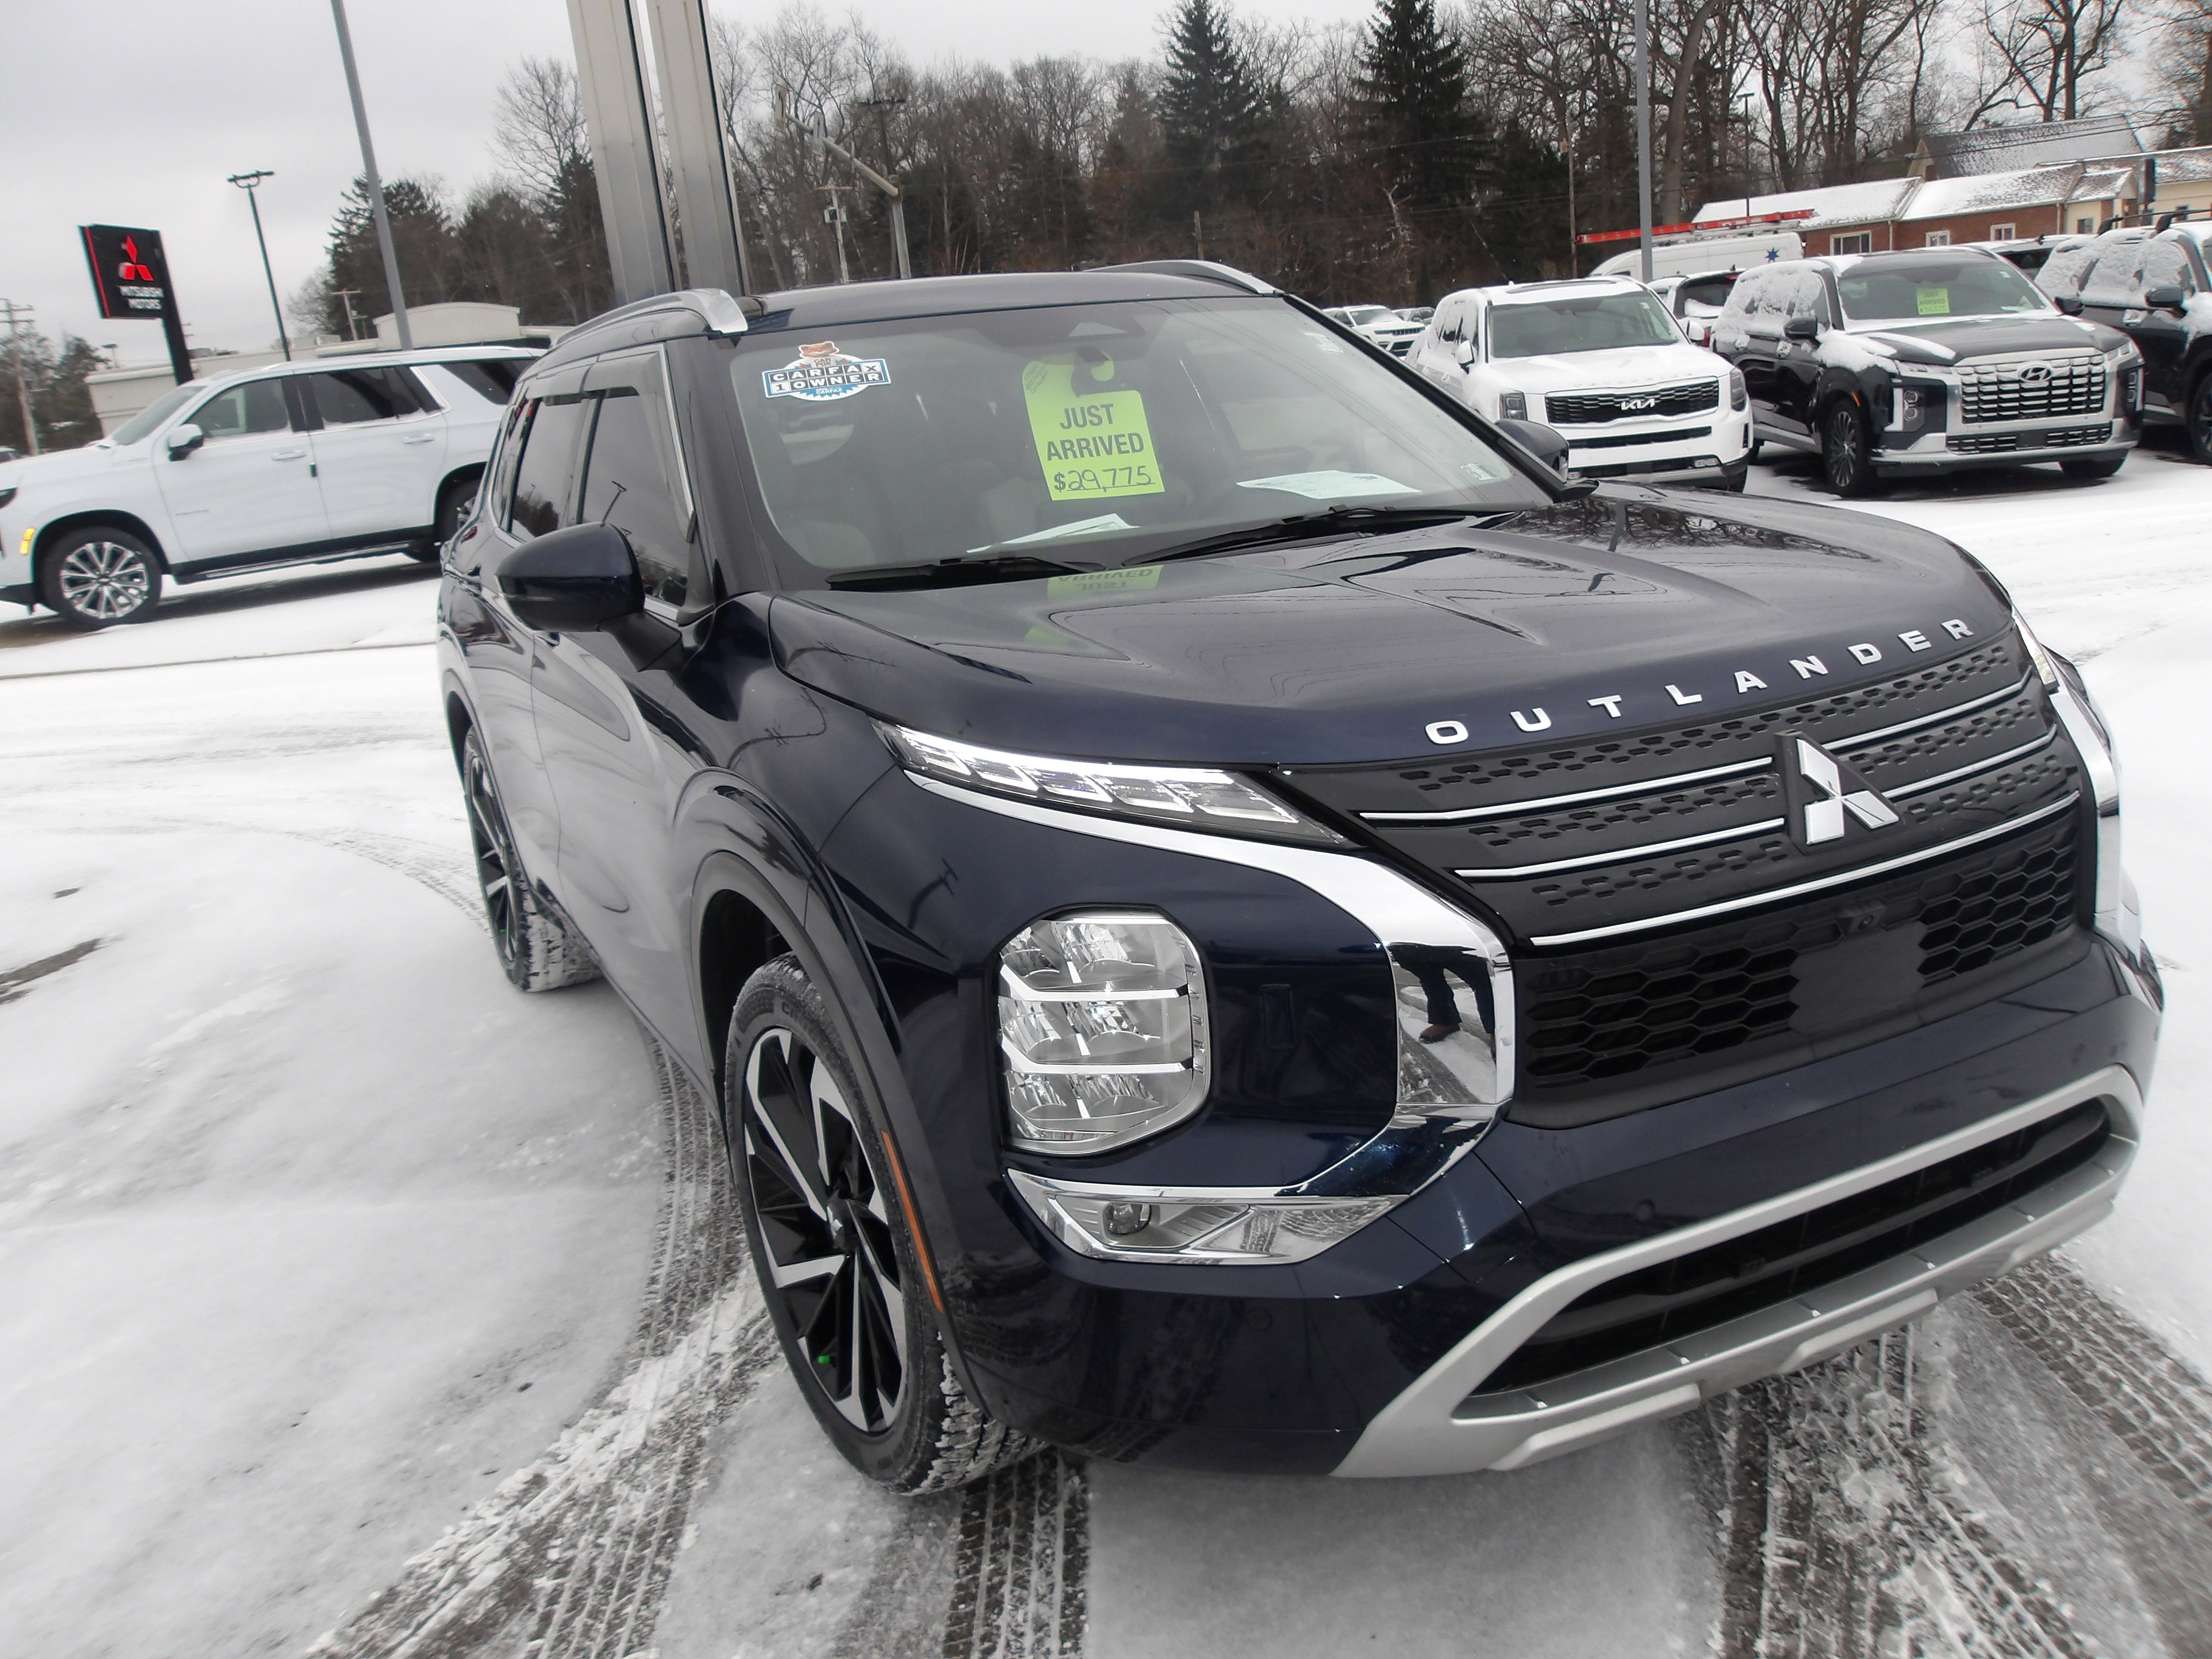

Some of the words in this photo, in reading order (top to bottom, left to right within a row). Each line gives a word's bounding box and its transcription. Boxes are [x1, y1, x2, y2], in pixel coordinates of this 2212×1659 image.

[773, 365, 879, 381] CARFAX
[793, 373, 879, 389] OWNER
[1060, 403, 1114, 430] JUST
[1046, 433, 1144, 461] ARRIVED
[1053, 465, 1153, 493] $29,775
[1425, 618, 1974, 745] OUTLANDER
